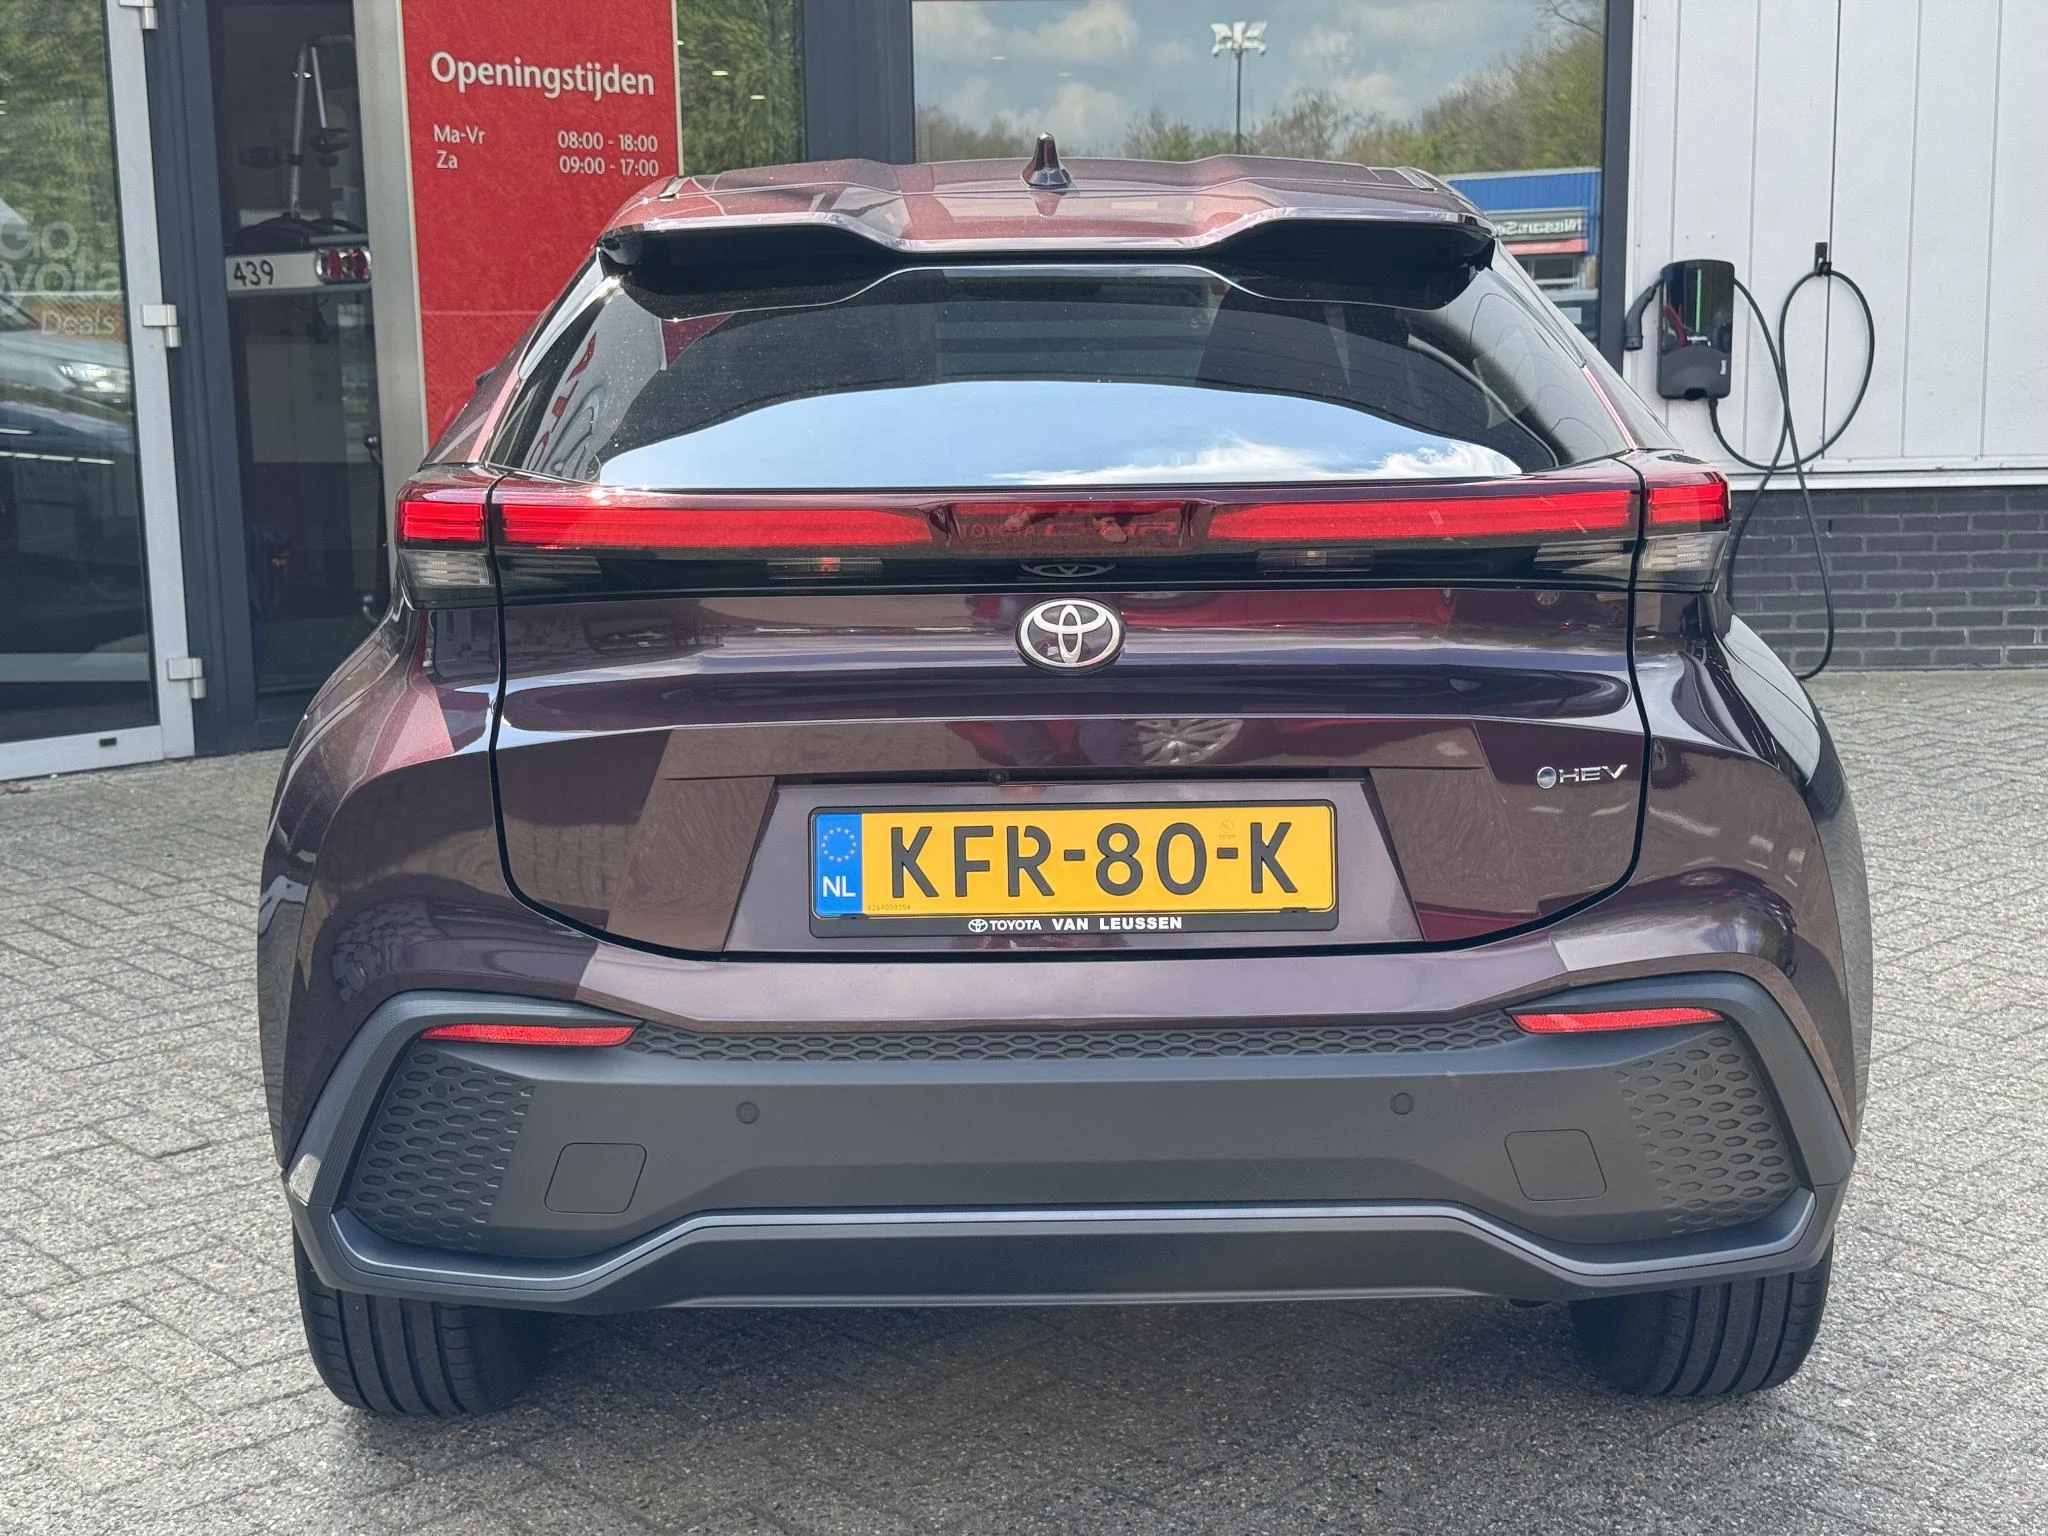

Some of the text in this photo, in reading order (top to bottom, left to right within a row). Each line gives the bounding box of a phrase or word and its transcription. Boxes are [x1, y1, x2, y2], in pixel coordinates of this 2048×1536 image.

[430, 51, 655, 101] Openingstijden
[433, 124, 486, 145] Ma-Vr
[557, 130, 604, 150] 08:00
[618, 133, 659, 153] 18:00
[435, 150, 459, 169] Za
[559, 155, 606, 175] 09:00
[620, 158, 660, 177] 17:00
[0, 254, 121, 310] yota
[233, 259, 275, 288] 439
[41, 308, 116, 336] Deals
[1558, 763, 1628, 784] HEV
[890, 821, 1299, 899] KFR-80-K
[822, 875, 857, 898] NL
[989, 916, 1182, 931] TOYOTA VAN LEUSSEN
